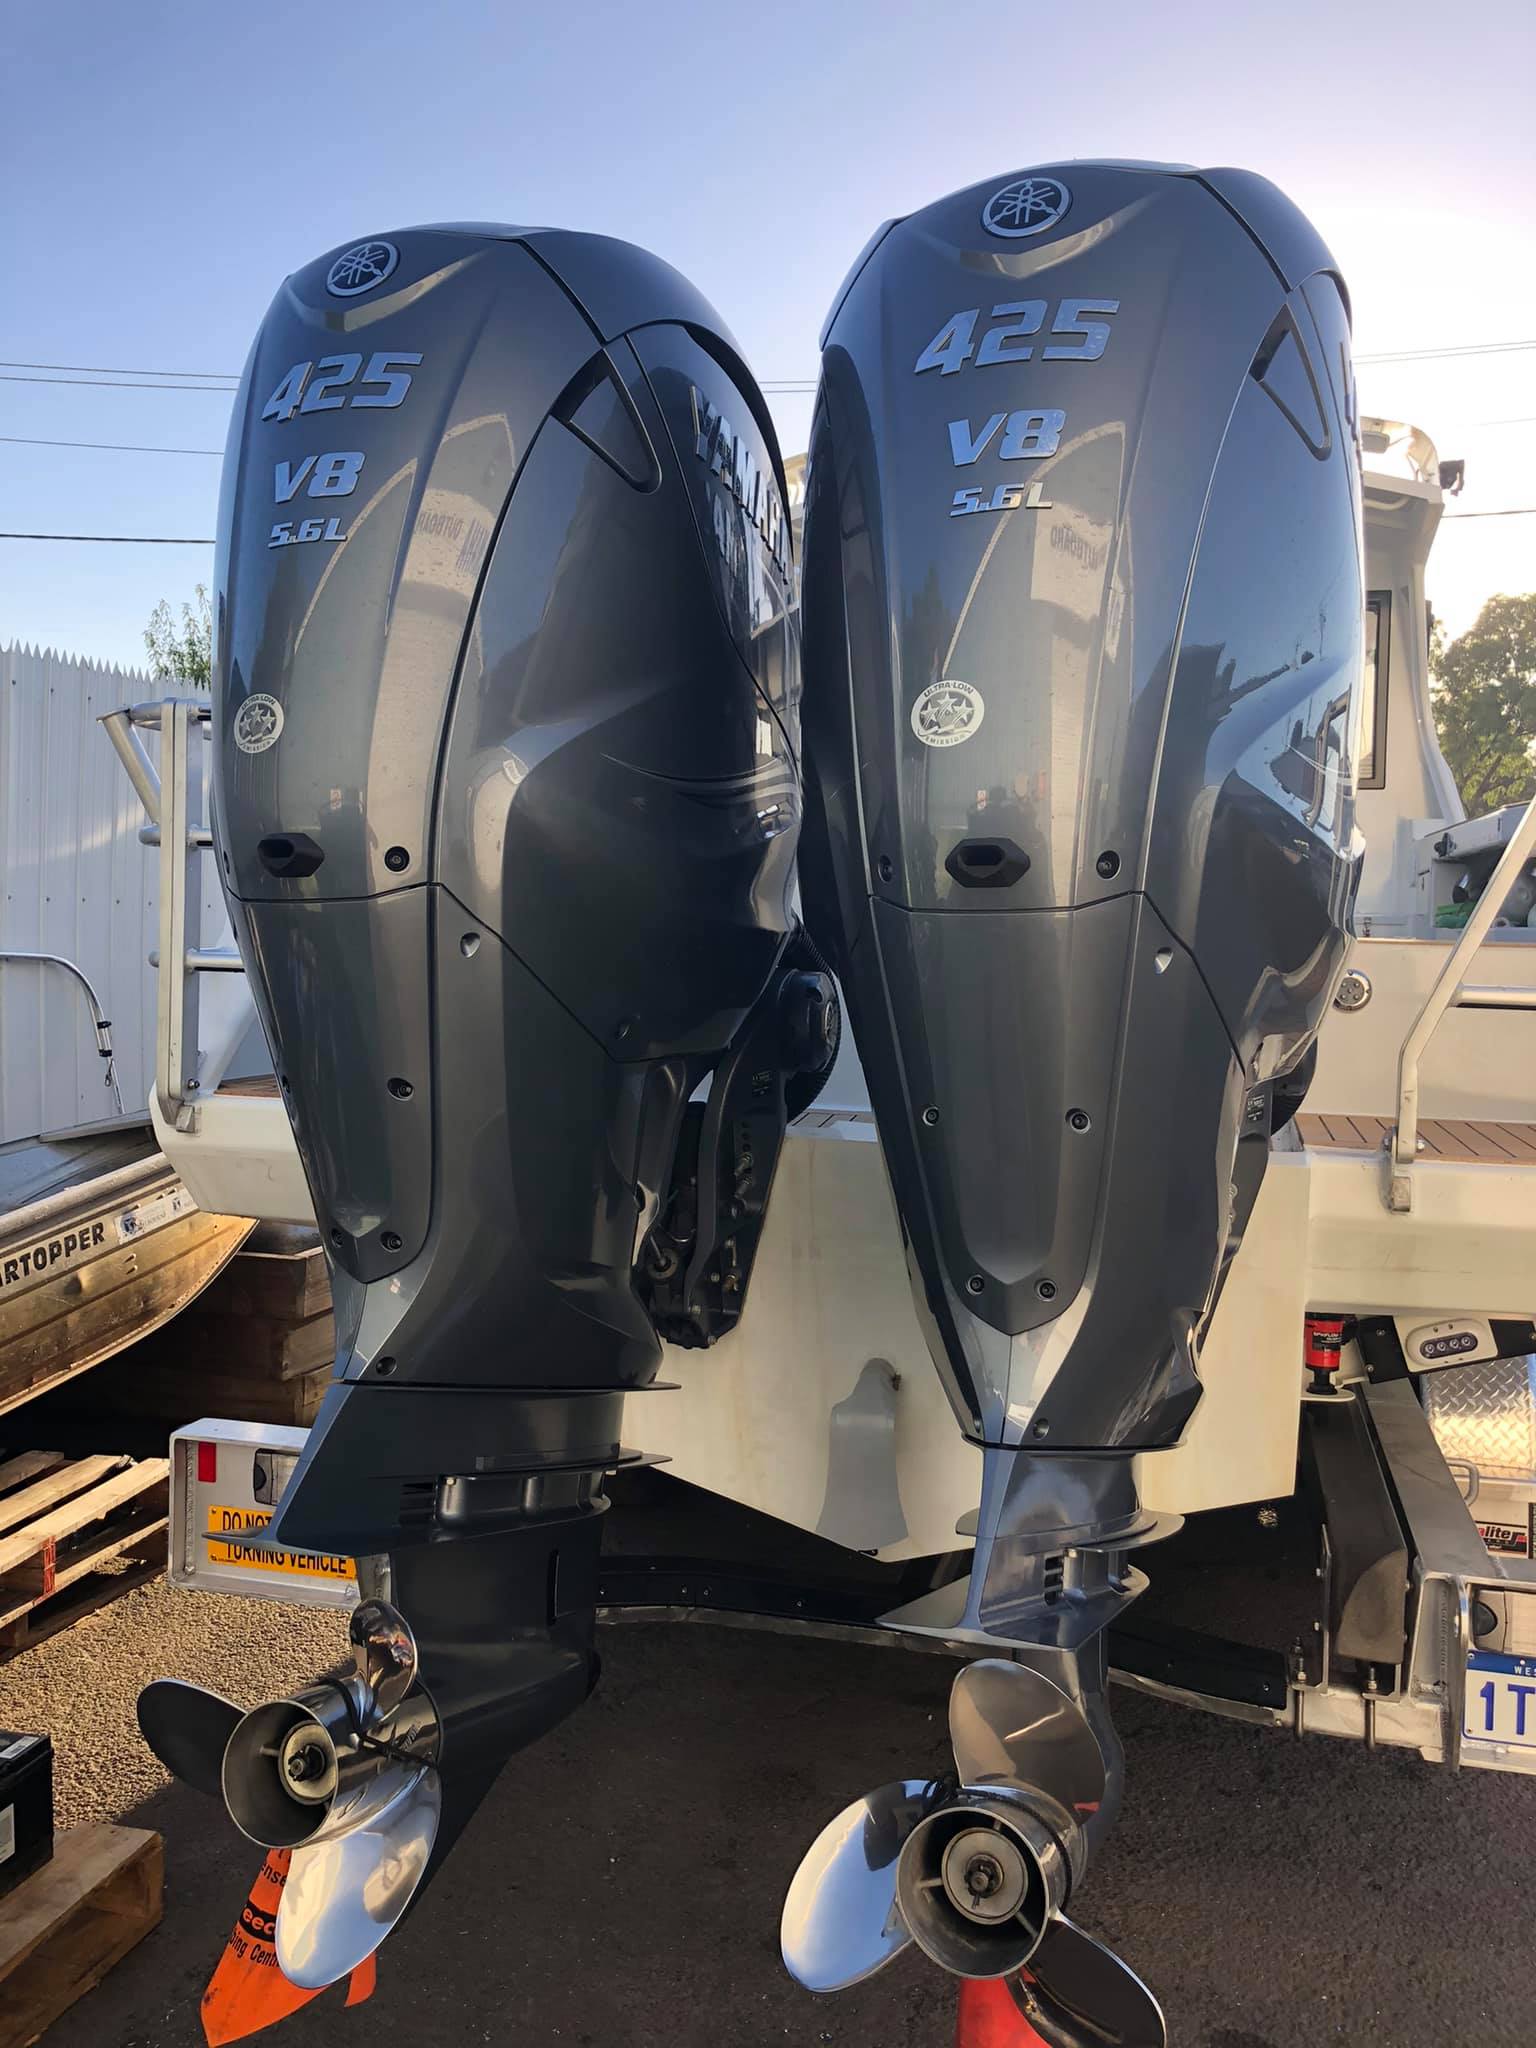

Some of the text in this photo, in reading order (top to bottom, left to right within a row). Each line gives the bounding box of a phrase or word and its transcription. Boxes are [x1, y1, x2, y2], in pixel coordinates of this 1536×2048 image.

[911, 298, 1121, 376] 425
[261, 351, 424, 422] 425
[948, 408, 1067, 466] V8
[275, 452, 365, 503] V8
[950, 481, 1053, 516] 5.6L
[268, 517, 348, 549] 5.6L
[923, 682, 974, 697] ULTRA LOW
[222, 1510, 242, 1531] DO
[290, 1553, 347, 1574] VEHICLE
[1480, 1681, 1536, 1736] 1T
